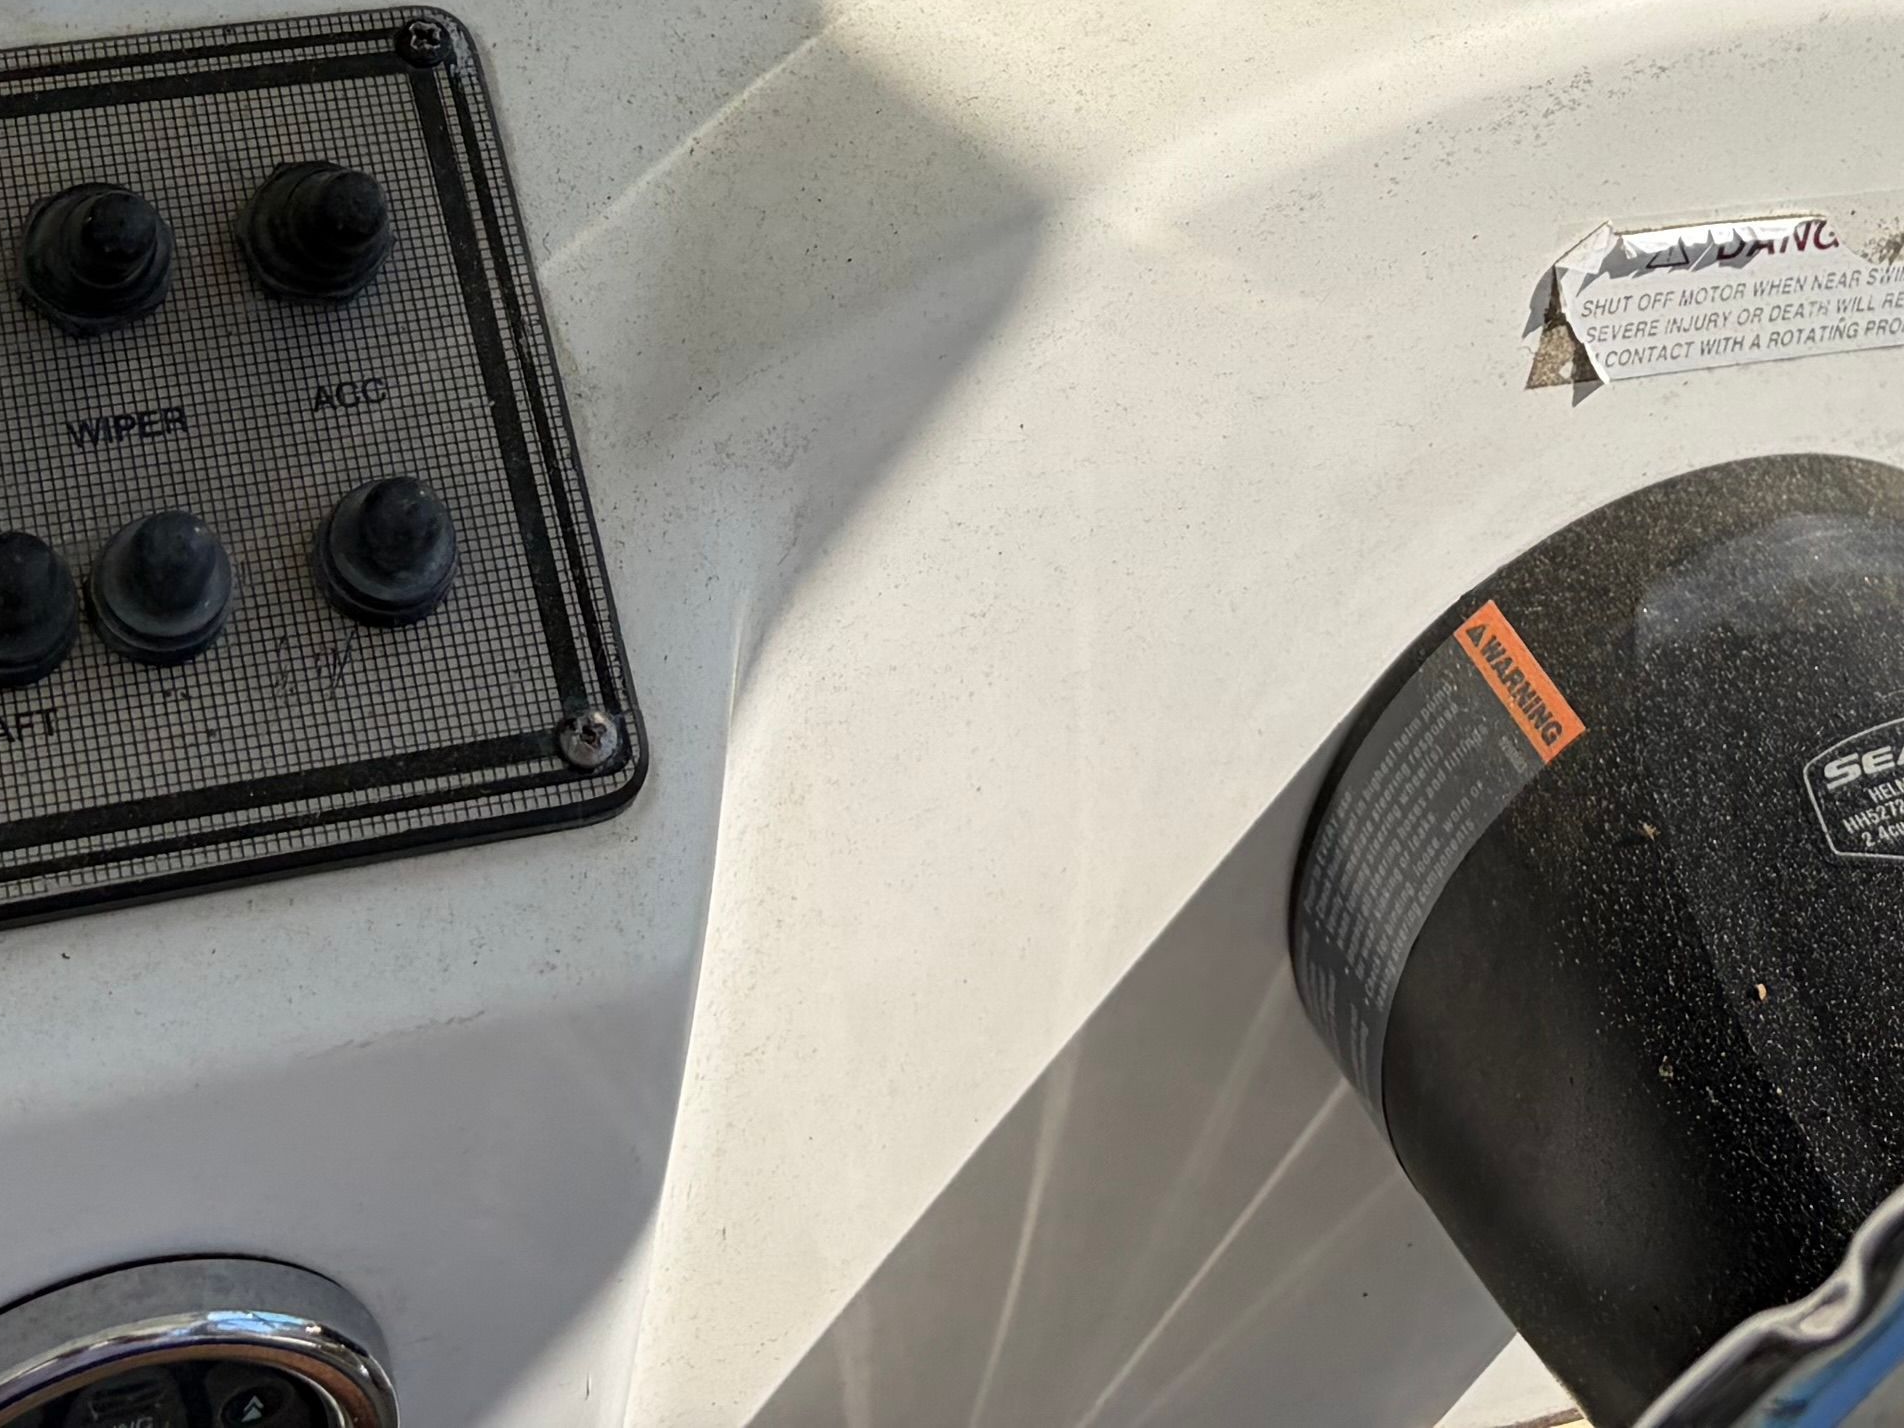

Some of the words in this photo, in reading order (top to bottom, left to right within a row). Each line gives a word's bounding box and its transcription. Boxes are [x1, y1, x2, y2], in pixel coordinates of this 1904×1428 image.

[1581, 296, 1631, 318] SHUT
[1637, 292, 1674, 312] OFF
[1679, 283, 1745, 306] MOTOR
[1753, 276, 1806, 297] WHEN
[1811, 270, 1861, 291] NEAR
[1586, 320, 1659, 343] SEVERE
[1665, 310, 1732, 335] INJURY
[1737, 308, 1764, 325] OR
[1769, 301, 1830, 322] DEATH
[1837, 297, 1875, 314] WILL
[1605, 342, 1695, 368] CONTACT
[1700, 337, 1745, 358] WITH
[1749, 335, 1761, 350] A
[1768, 322, 1859, 347] ROTATING
[313, 379, 389, 414] ACC
[67, 407, 188, 451] WIPER
[1481, 635, 1563, 746] WARNING
